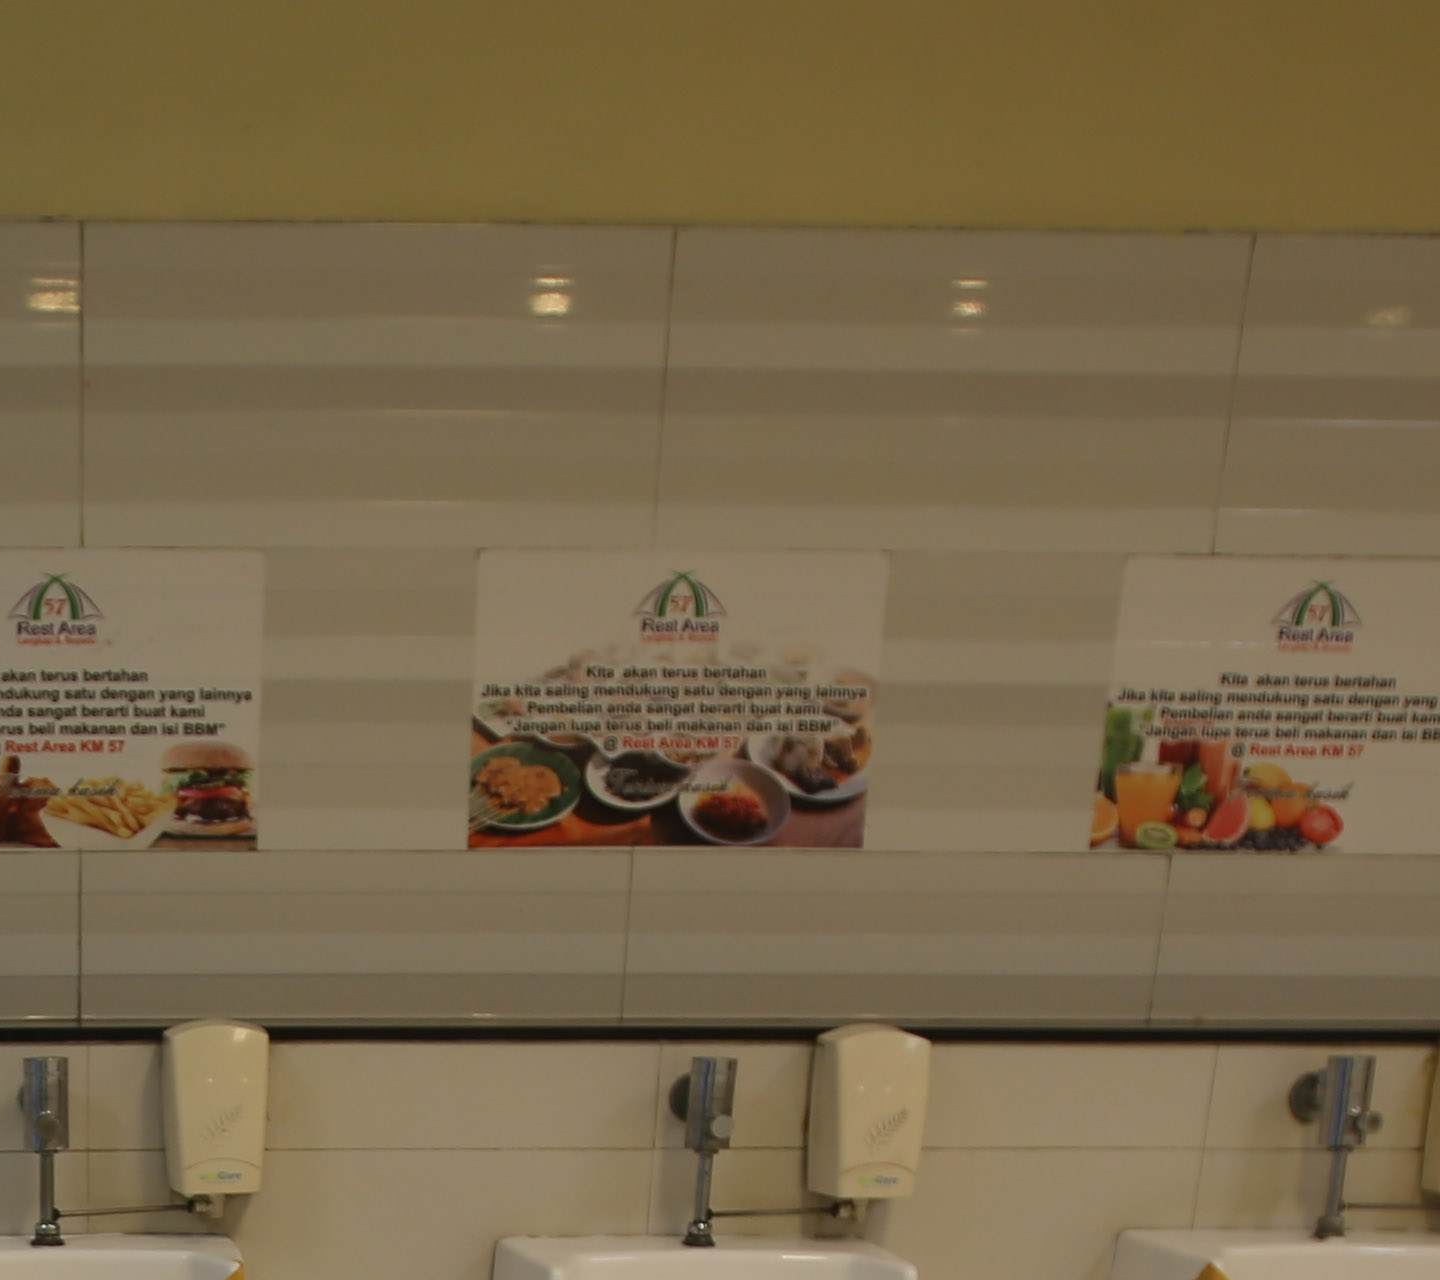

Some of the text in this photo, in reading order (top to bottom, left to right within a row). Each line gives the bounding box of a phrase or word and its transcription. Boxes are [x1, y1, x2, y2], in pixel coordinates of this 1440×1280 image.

[44, 598, 66, 614] 57
[17, 621, 96, 635] Rest Area
[0, 669, 35, 681] akan
[40, 669, 77, 681] terus
[83, 669, 148, 681] bertahan
[64, 688, 95, 699] satu
[100, 688, 154, 702] dengan
[159, 689, 194, 702] yang
[199, 688, 252, 703] lainnya
[27, 705, 76, 720] sangat
[81, 705, 128, 717] berarti
[133, 705, 165, 717] buat
[170, 705, 205, 717] kami
[28, 723, 54, 735] beli
[59, 723, 126, 735] makanan
[130, 723, 157, 735] dan
[161, 723, 178, 735] isi
[5, 740, 37, 752] Rest
[41, 740, 75, 752] Area
[79, 740, 103, 752] KM
[109, 740, 125, 752] 57
